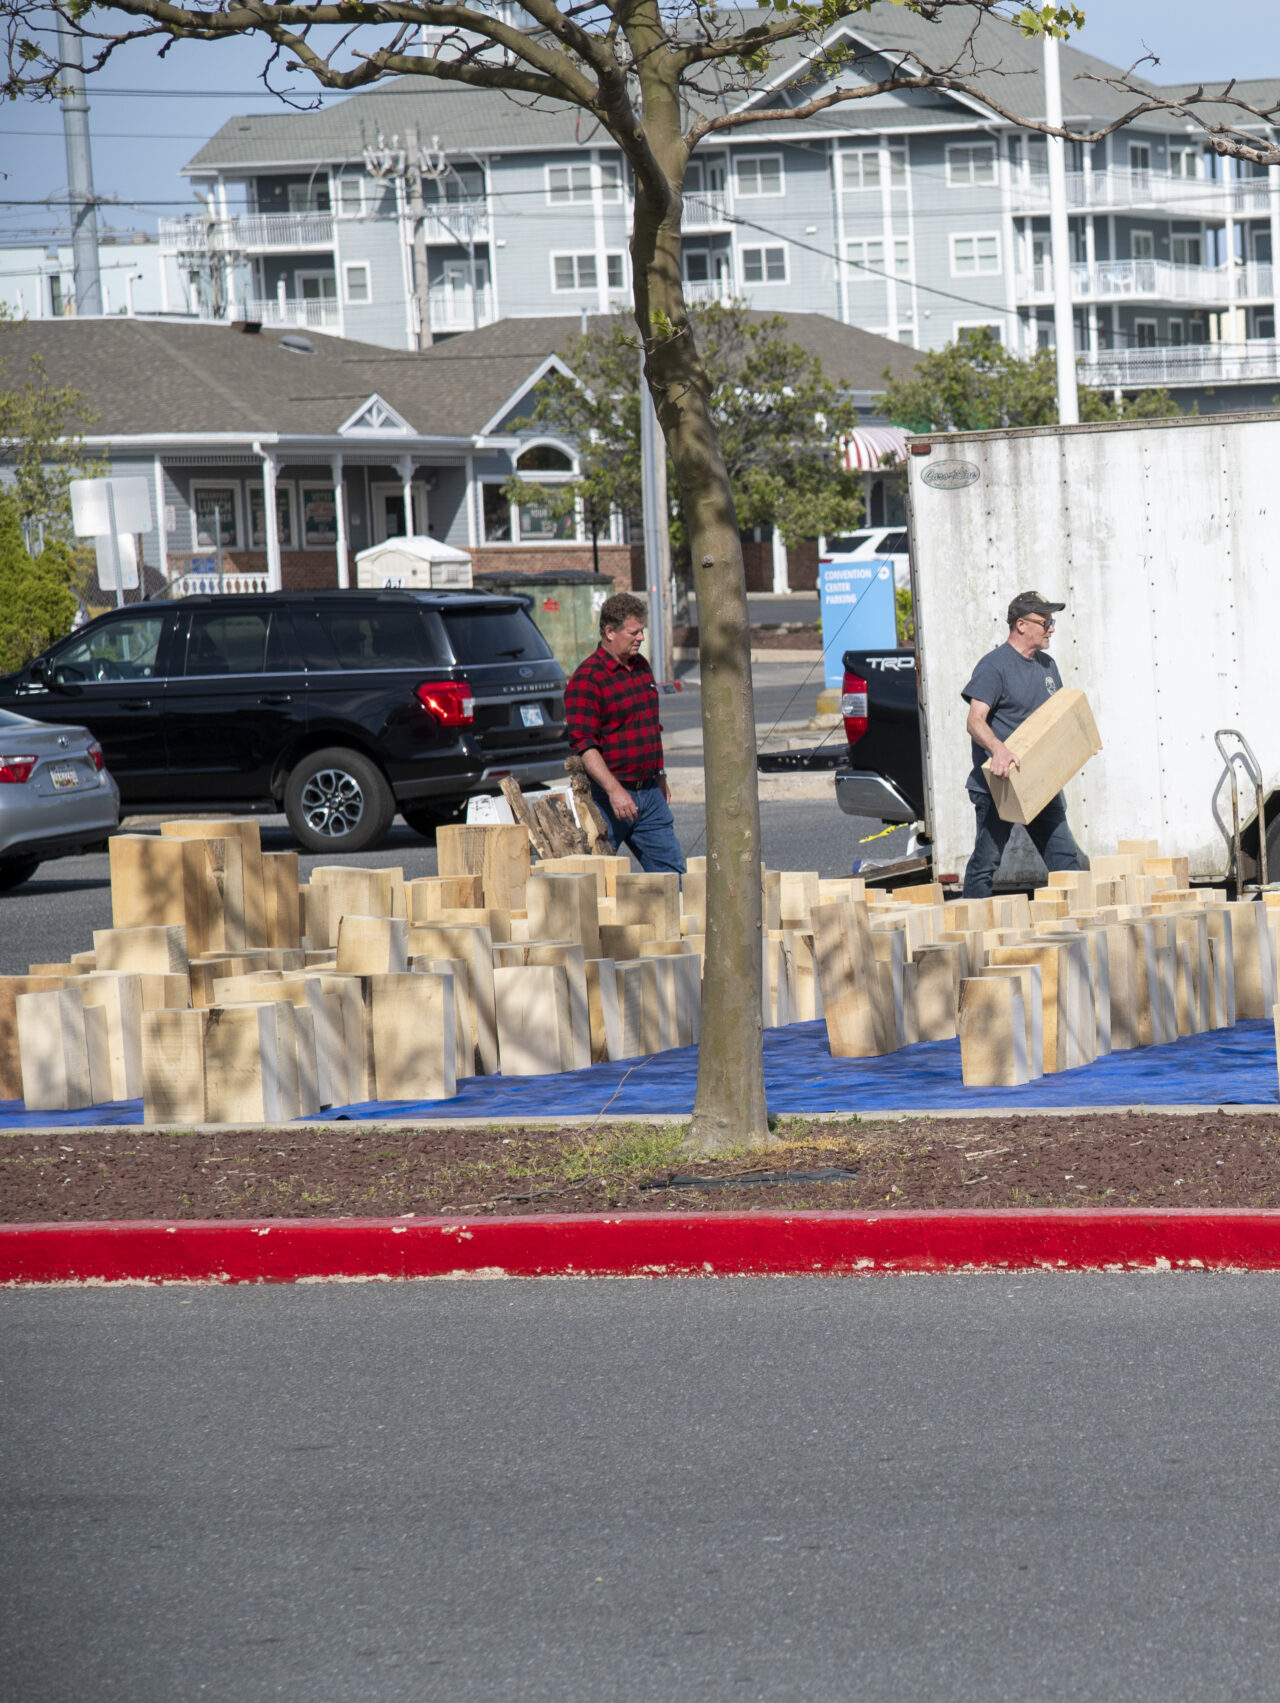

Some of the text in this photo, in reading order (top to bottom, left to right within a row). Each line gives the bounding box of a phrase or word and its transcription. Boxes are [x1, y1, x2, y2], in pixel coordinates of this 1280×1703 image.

[824, 569, 872, 581] CONVENTION
[825, 582, 850, 593] CENTER
[825, 593, 857, 605] PARKING
[866, 656, 915, 672] TRD
